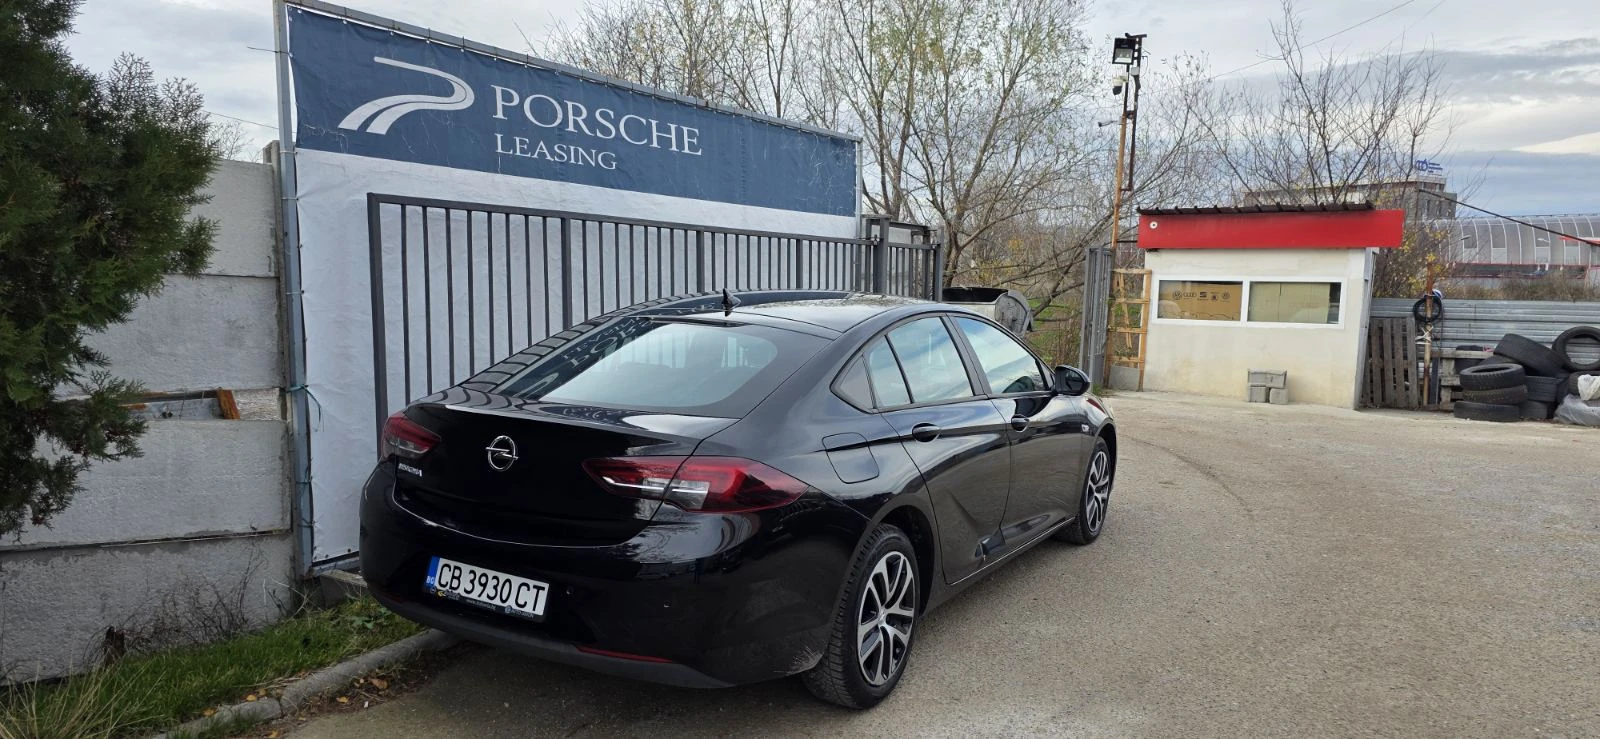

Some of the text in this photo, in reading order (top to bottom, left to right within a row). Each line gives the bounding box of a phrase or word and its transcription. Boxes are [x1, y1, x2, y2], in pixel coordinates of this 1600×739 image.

[490, 85, 702, 155] PORSCHE
[494, 133, 617, 169] LEASING
[438, 564, 462, 591] CB
[464, 570, 512, 603] 3930
[515, 582, 545, 611] CT
